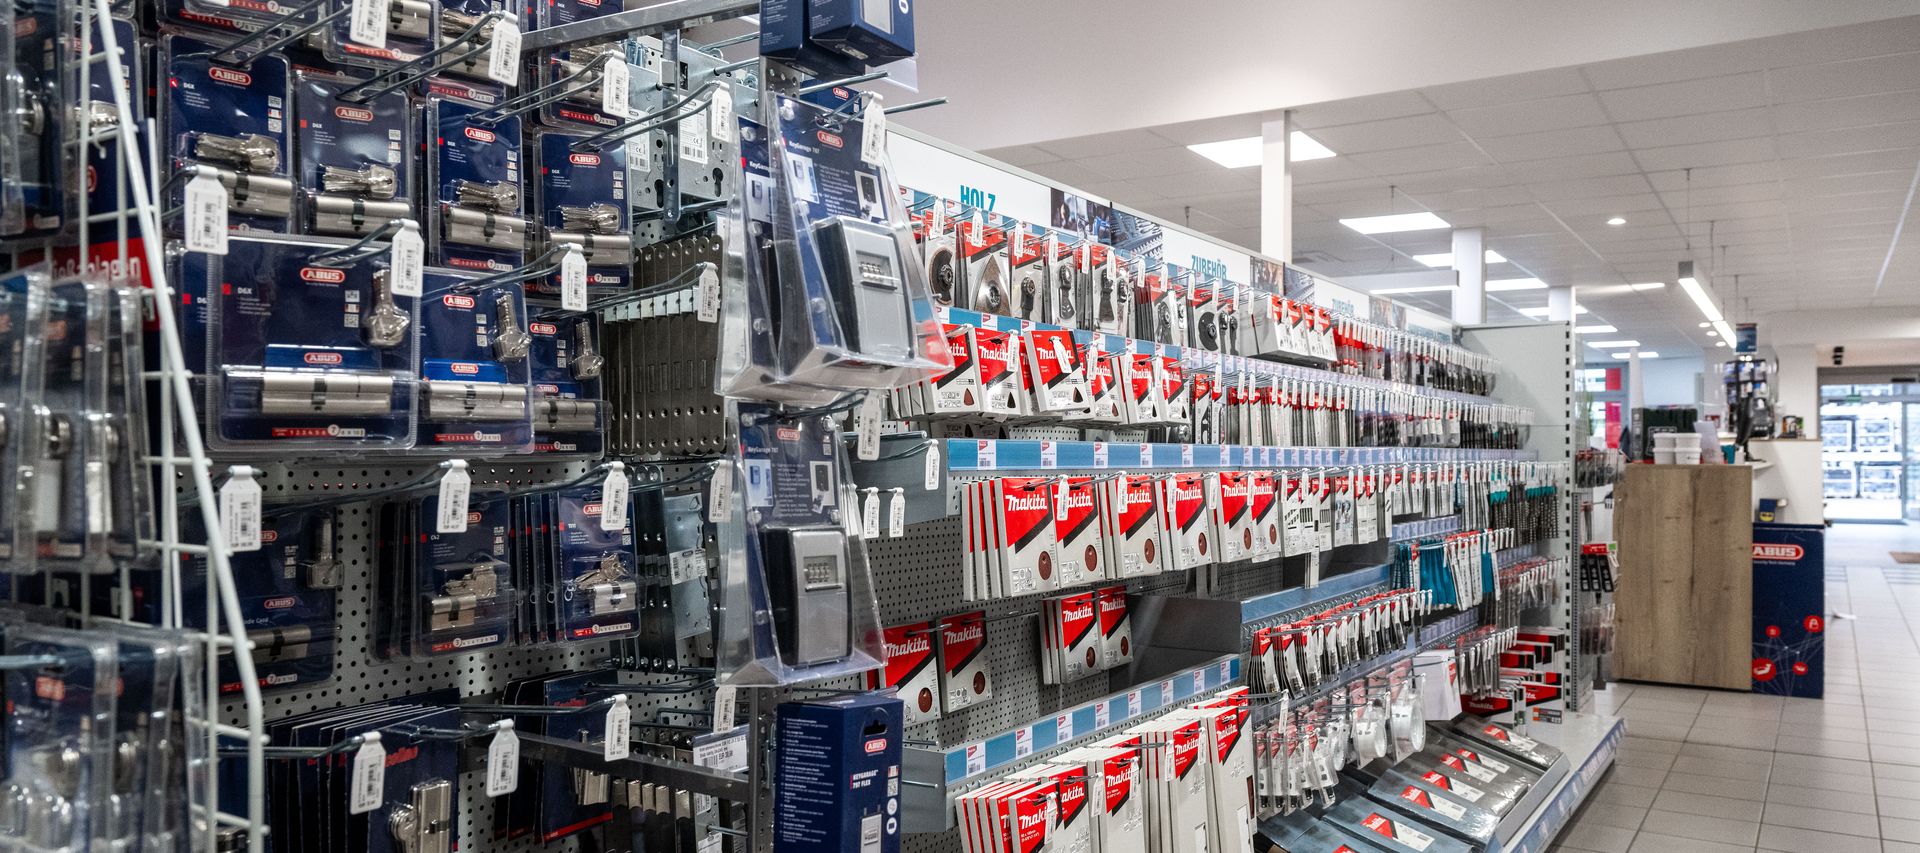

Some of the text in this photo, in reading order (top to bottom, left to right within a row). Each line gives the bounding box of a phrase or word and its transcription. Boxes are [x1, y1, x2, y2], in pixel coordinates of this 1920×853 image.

[214, 69, 250, 84] ABUS
[340, 109, 369, 119] ABUS
[468, 130, 492, 140] ABUS
[573, 156, 597, 164] ABUS
[960, 185, 996, 212] HOLZ
[306, 271, 340, 281] ABUS
[448, 296, 472, 306] ABUS
[308, 354, 338, 362] ABUS
[1753, 546, 1796, 557] ABUS
